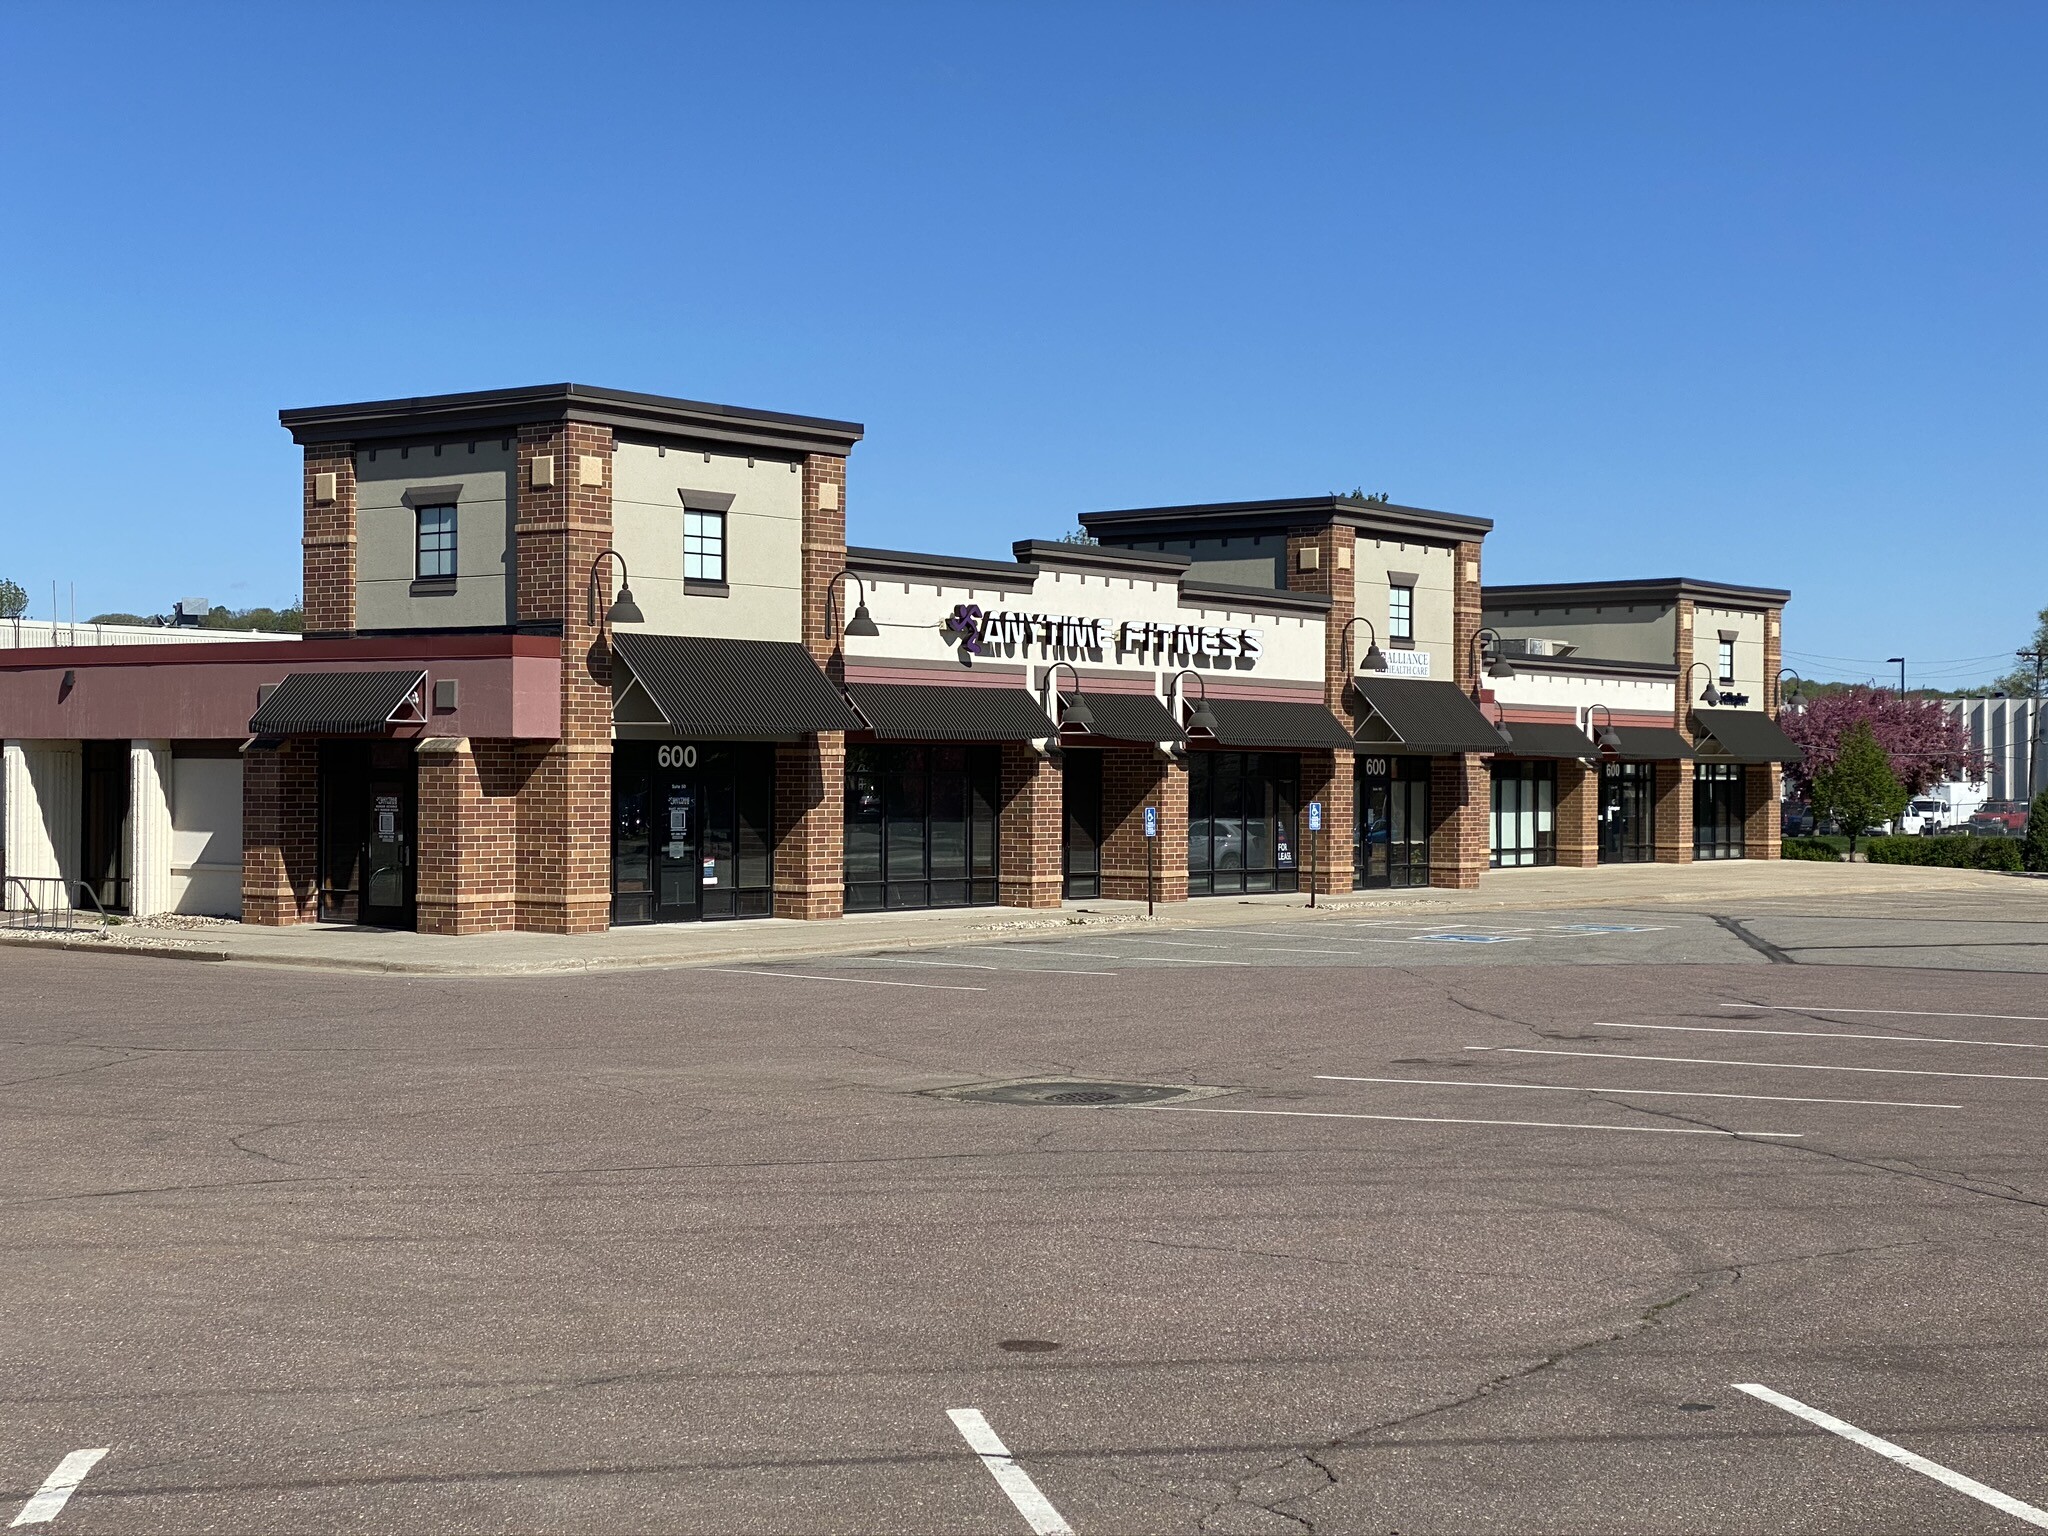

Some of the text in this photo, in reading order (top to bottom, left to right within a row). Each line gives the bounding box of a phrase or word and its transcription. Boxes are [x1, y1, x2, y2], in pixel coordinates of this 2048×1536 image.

[981, 610, 1264, 660] ANYTIME FITNESS
[1387, 652, 1428, 665] ALLIANCE
[1412, 666, 1428, 675] CARE
[658, 745, 697, 768] 600
[1366, 758, 1386, 775] 600
[1606, 763, 1620, 777] 600
[1277, 843, 1288, 851] FOR
[1277, 852, 1292, 861] LEASE
